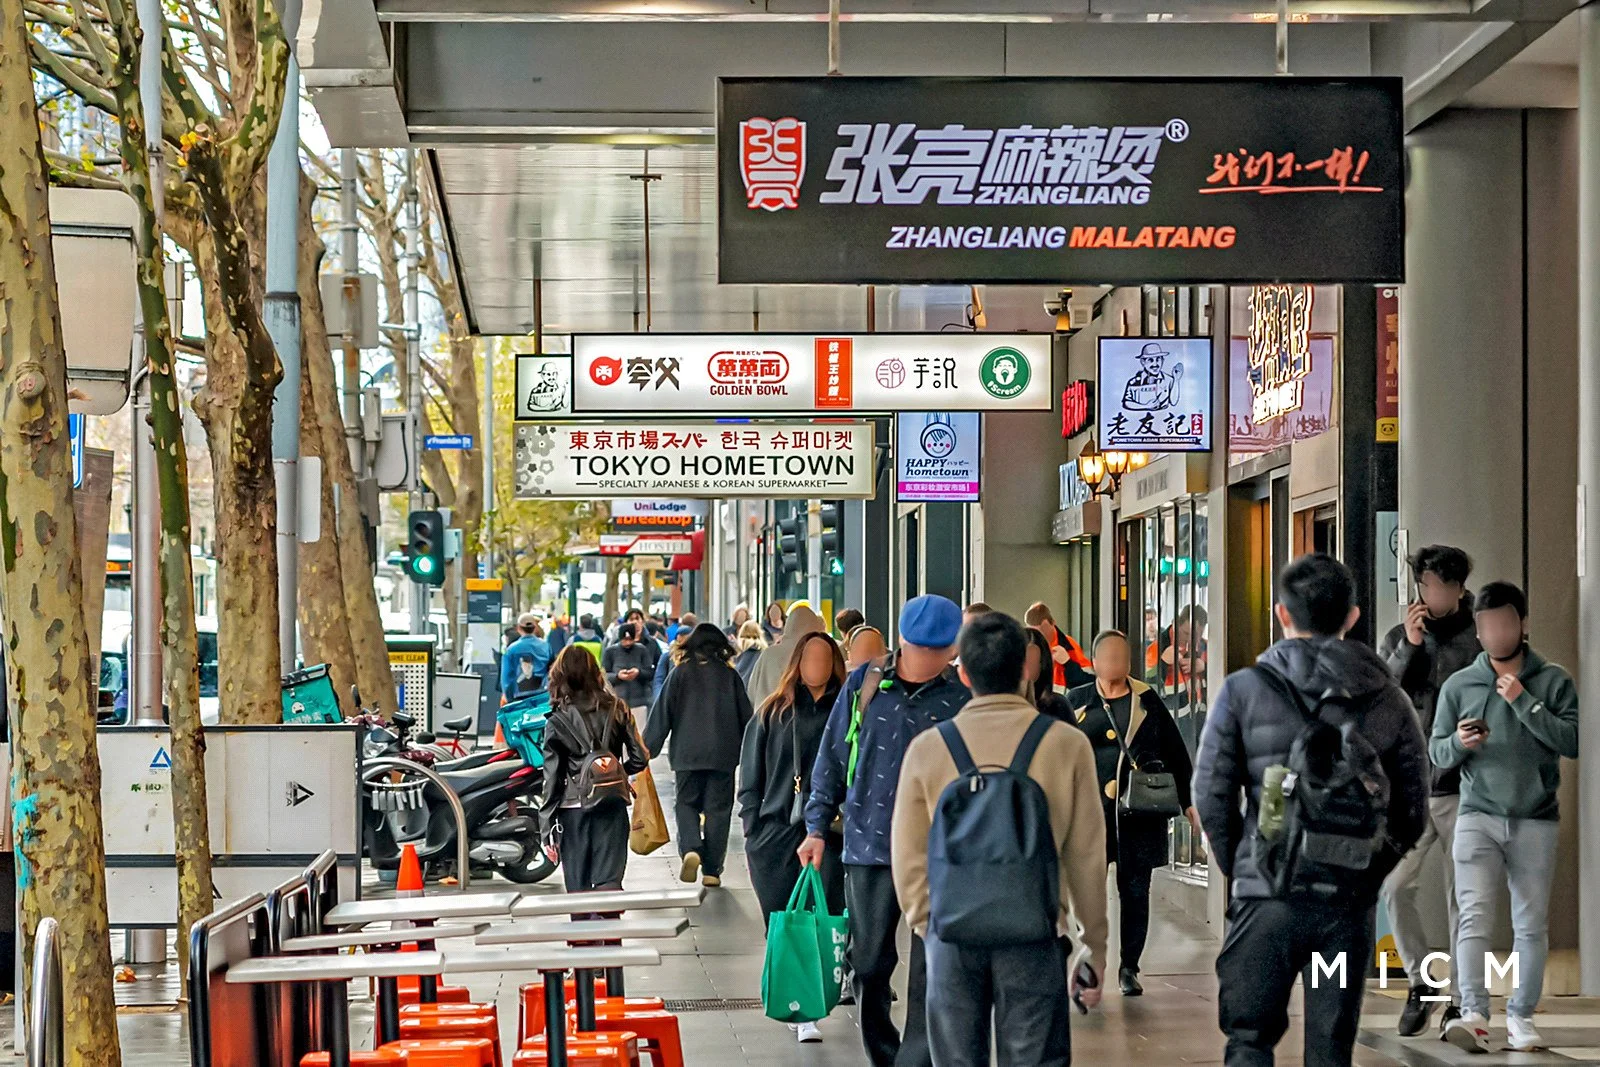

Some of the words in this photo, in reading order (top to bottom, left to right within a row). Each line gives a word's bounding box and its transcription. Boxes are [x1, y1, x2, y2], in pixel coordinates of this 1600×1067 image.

[819, 123, 1165, 204] 张亮麻辣烫
[974, 185, 1150, 204] ZHANGLIANG
[886, 226, 1066, 248] ZHANGLIANG
[1069, 226, 1236, 248] MALATANG
[627, 356, 680, 392] 夸父
[709, 385, 753, 396] GOLDEN
[756, 385, 789, 396] BOWL
[1107, 411, 1191, 436] 老友記
[569, 430, 708, 450] 東京市場スーパー
[721, 431, 761, 450] 한국
[770, 430, 853, 450] 슈퍼마켓
[570, 455, 672, 476] TOKYO
[681, 455, 855, 476] HOMETOWN
[905, 458, 948, 467] HAPPY
[905, 466, 969, 476] hometown
[598, 479, 649, 488] SPECIALTY
[652, 479, 700, 488] JAPANESE
[702, 479, 711, 488] &
[713, 479, 755, 488] KOREAN
[758, 479, 828, 488] SUPERMARKET
[634, 502, 687, 512] UniLodge
